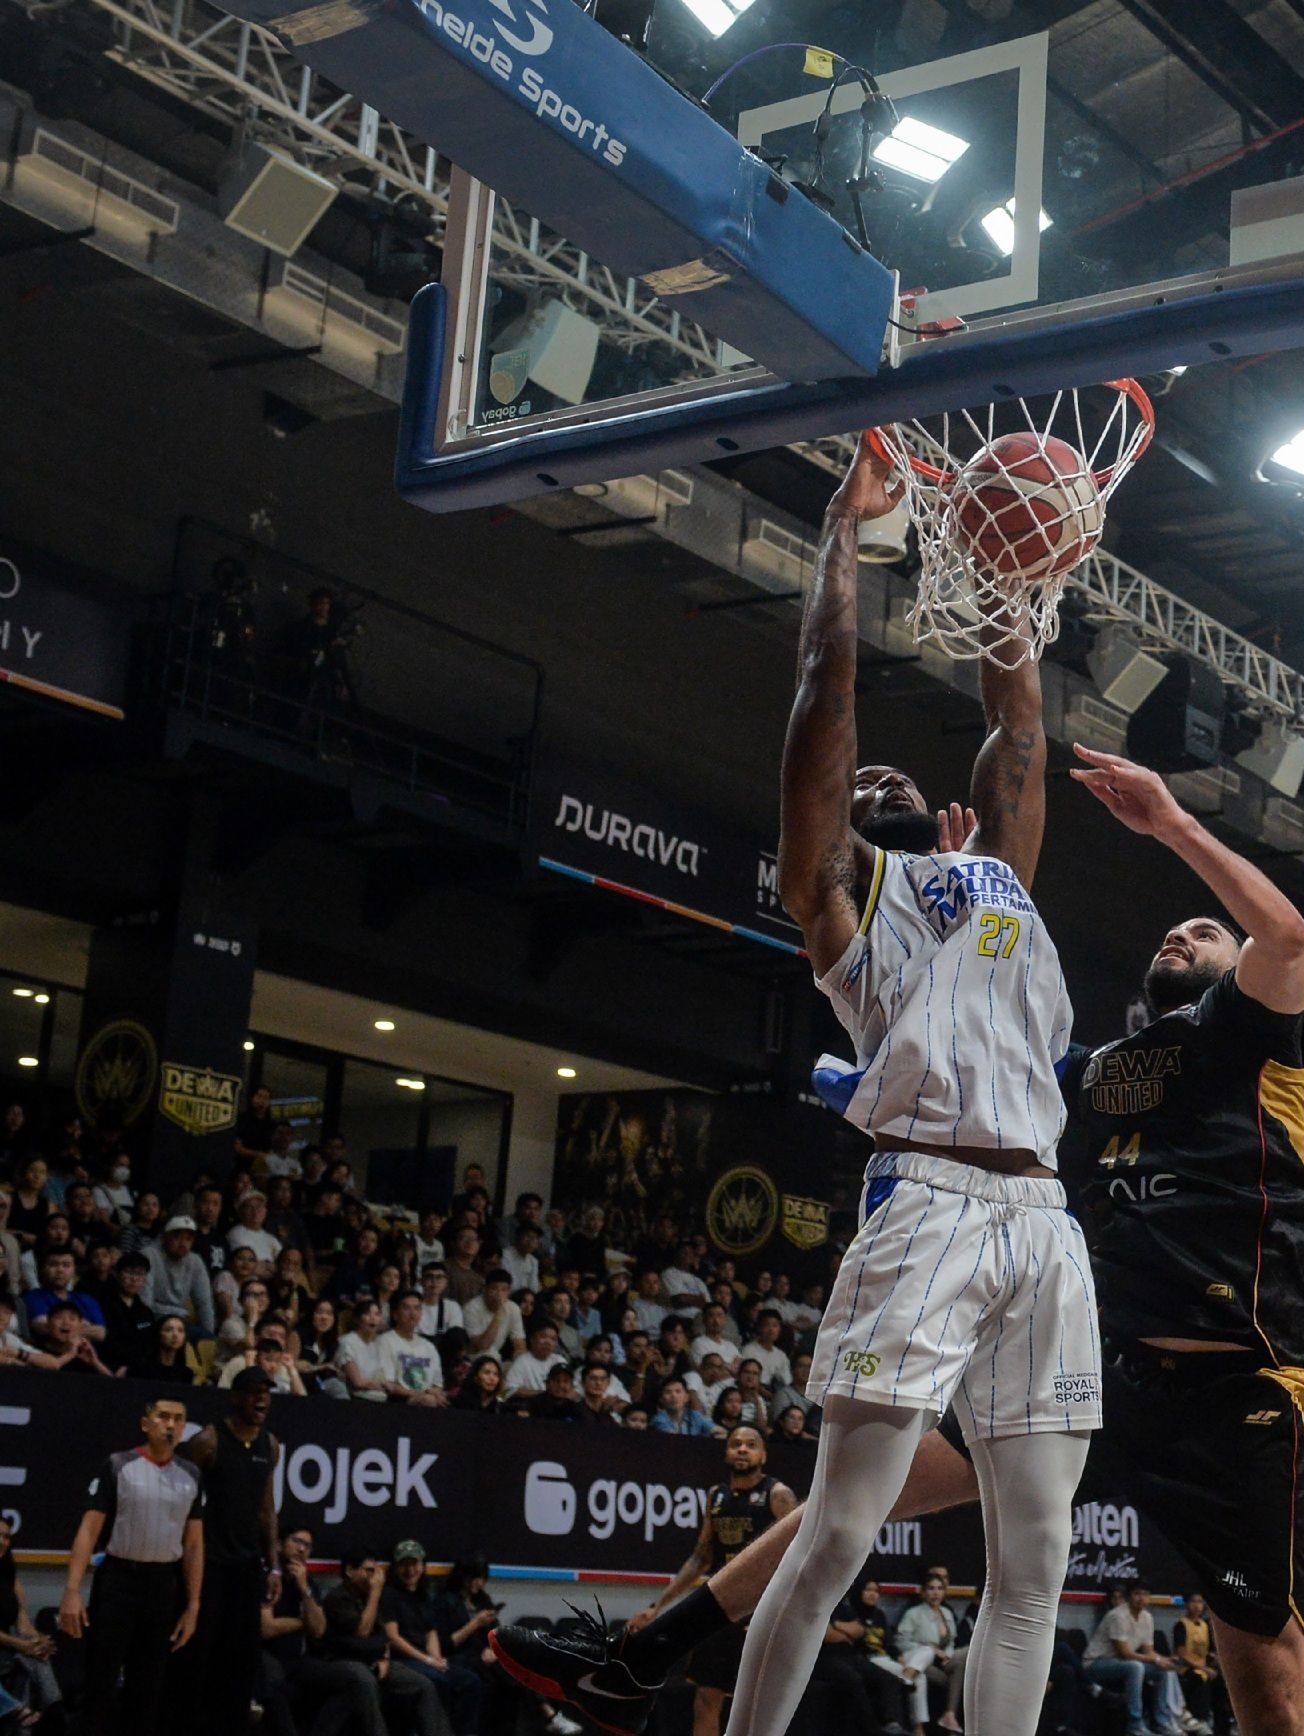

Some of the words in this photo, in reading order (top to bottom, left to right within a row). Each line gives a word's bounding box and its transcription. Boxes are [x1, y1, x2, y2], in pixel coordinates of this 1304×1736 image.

[519, 67, 627, 166] Sports
[978, 914, 1020, 958] 27
[165, 1069, 234, 1102] DEWA
[1082, 1046, 1183, 1089] DEWA
[1092, 1080, 1164, 1115] UNITED
[1098, 1132, 1141, 1171] 44
[1054, 1379, 1095, 1391] ROYAL
[273, 1436, 439, 1524] ojek
